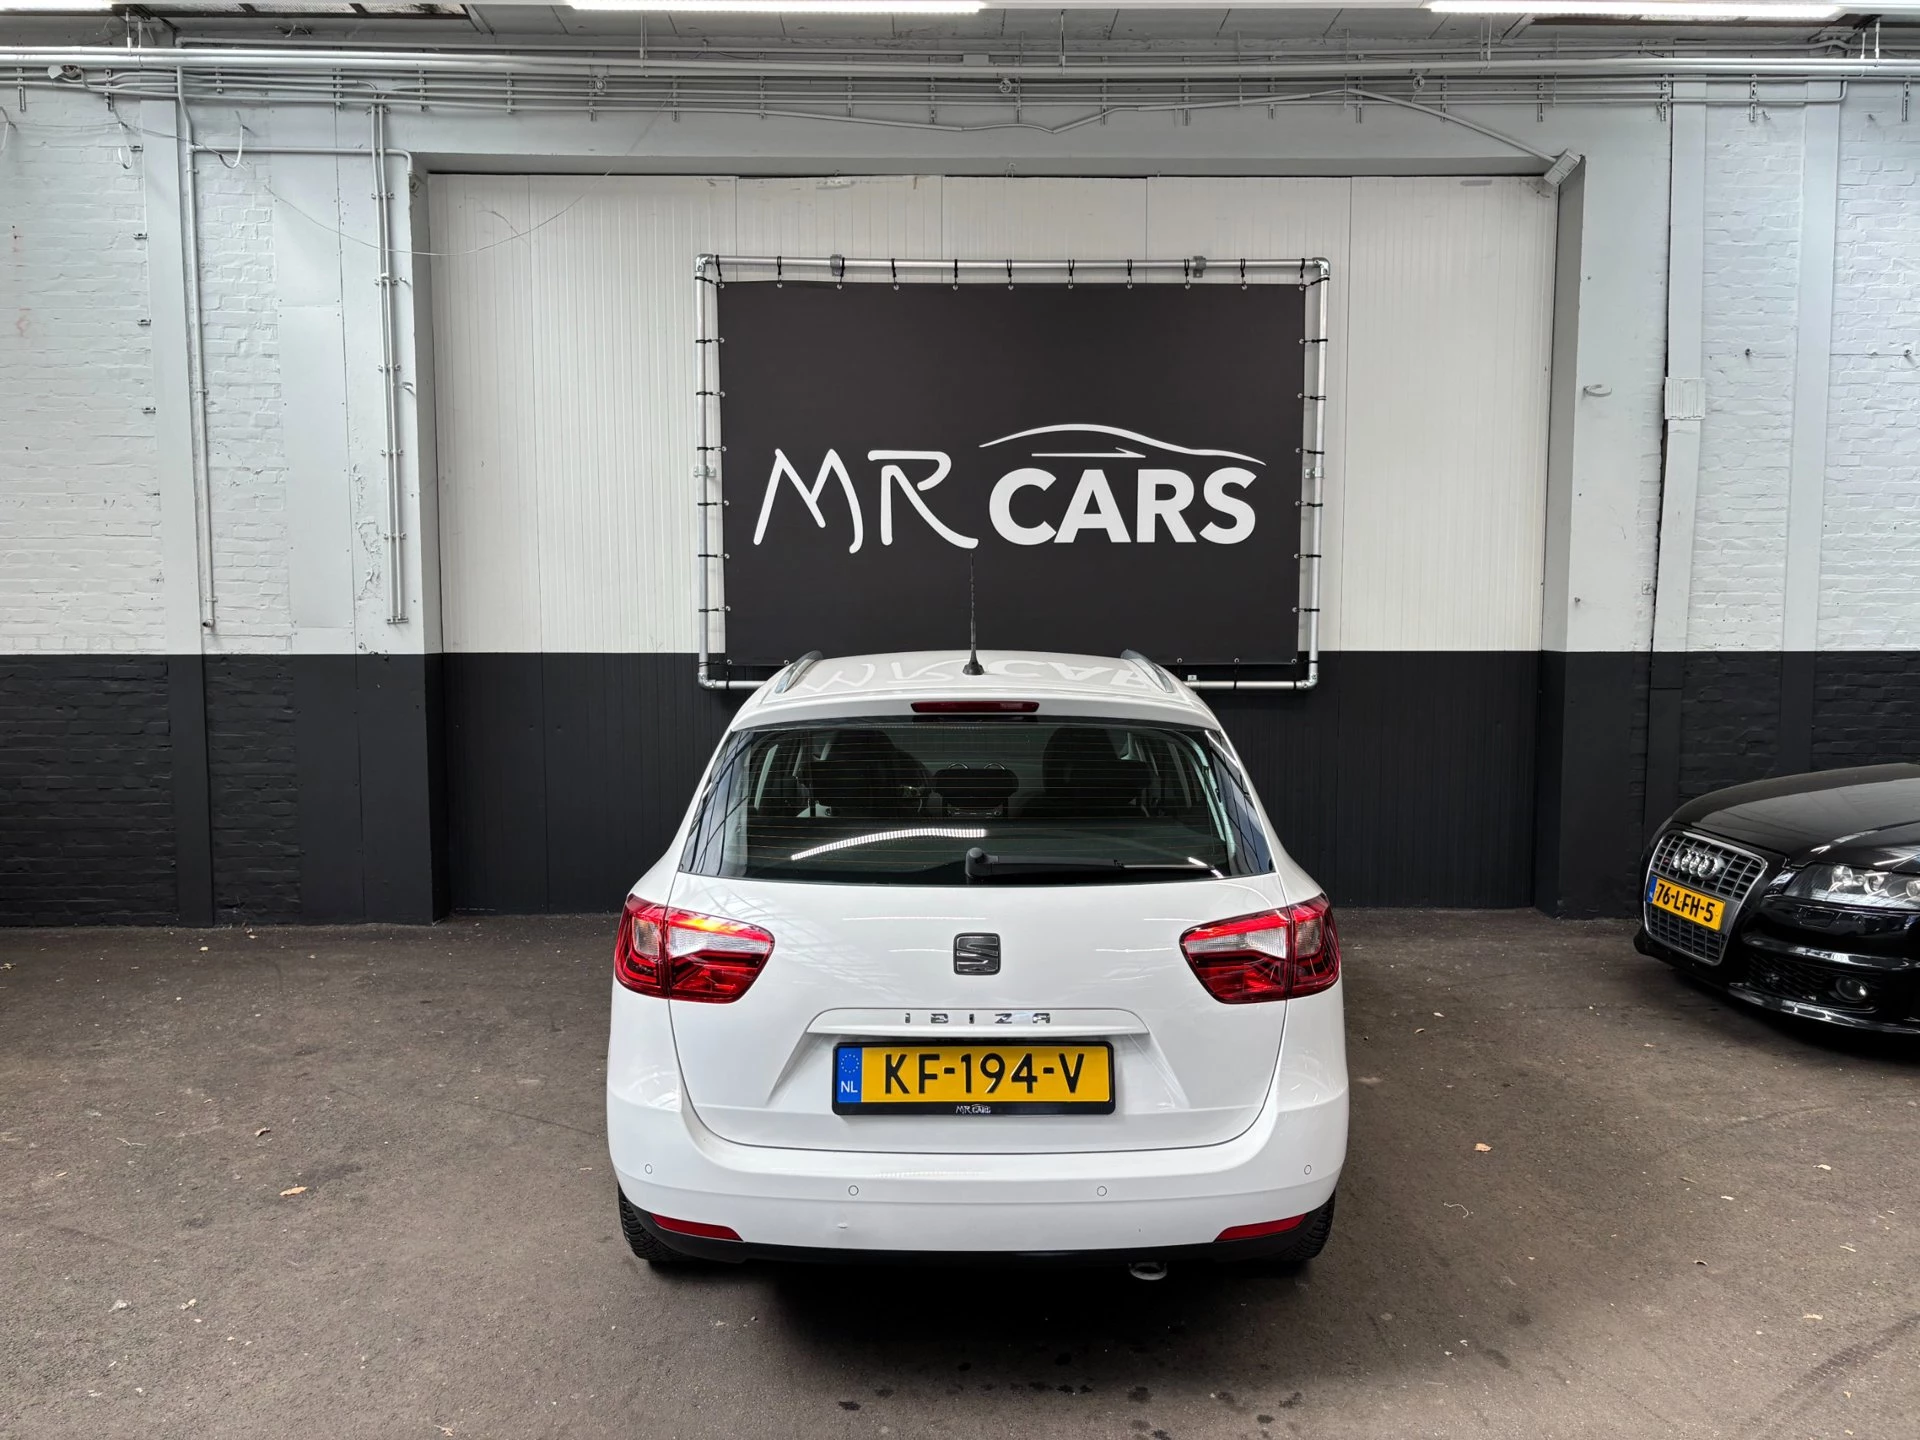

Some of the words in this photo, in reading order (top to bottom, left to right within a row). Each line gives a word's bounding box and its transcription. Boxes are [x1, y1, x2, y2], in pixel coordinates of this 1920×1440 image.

[753, 448, 979, 554] MR
[989, 467, 1257, 545] CARS
[1656, 883, 1716, 923] 76-LFH-5
[840, 1080, 858, 1093] NL
[884, 1053, 1085, 1094] KF-194-V
